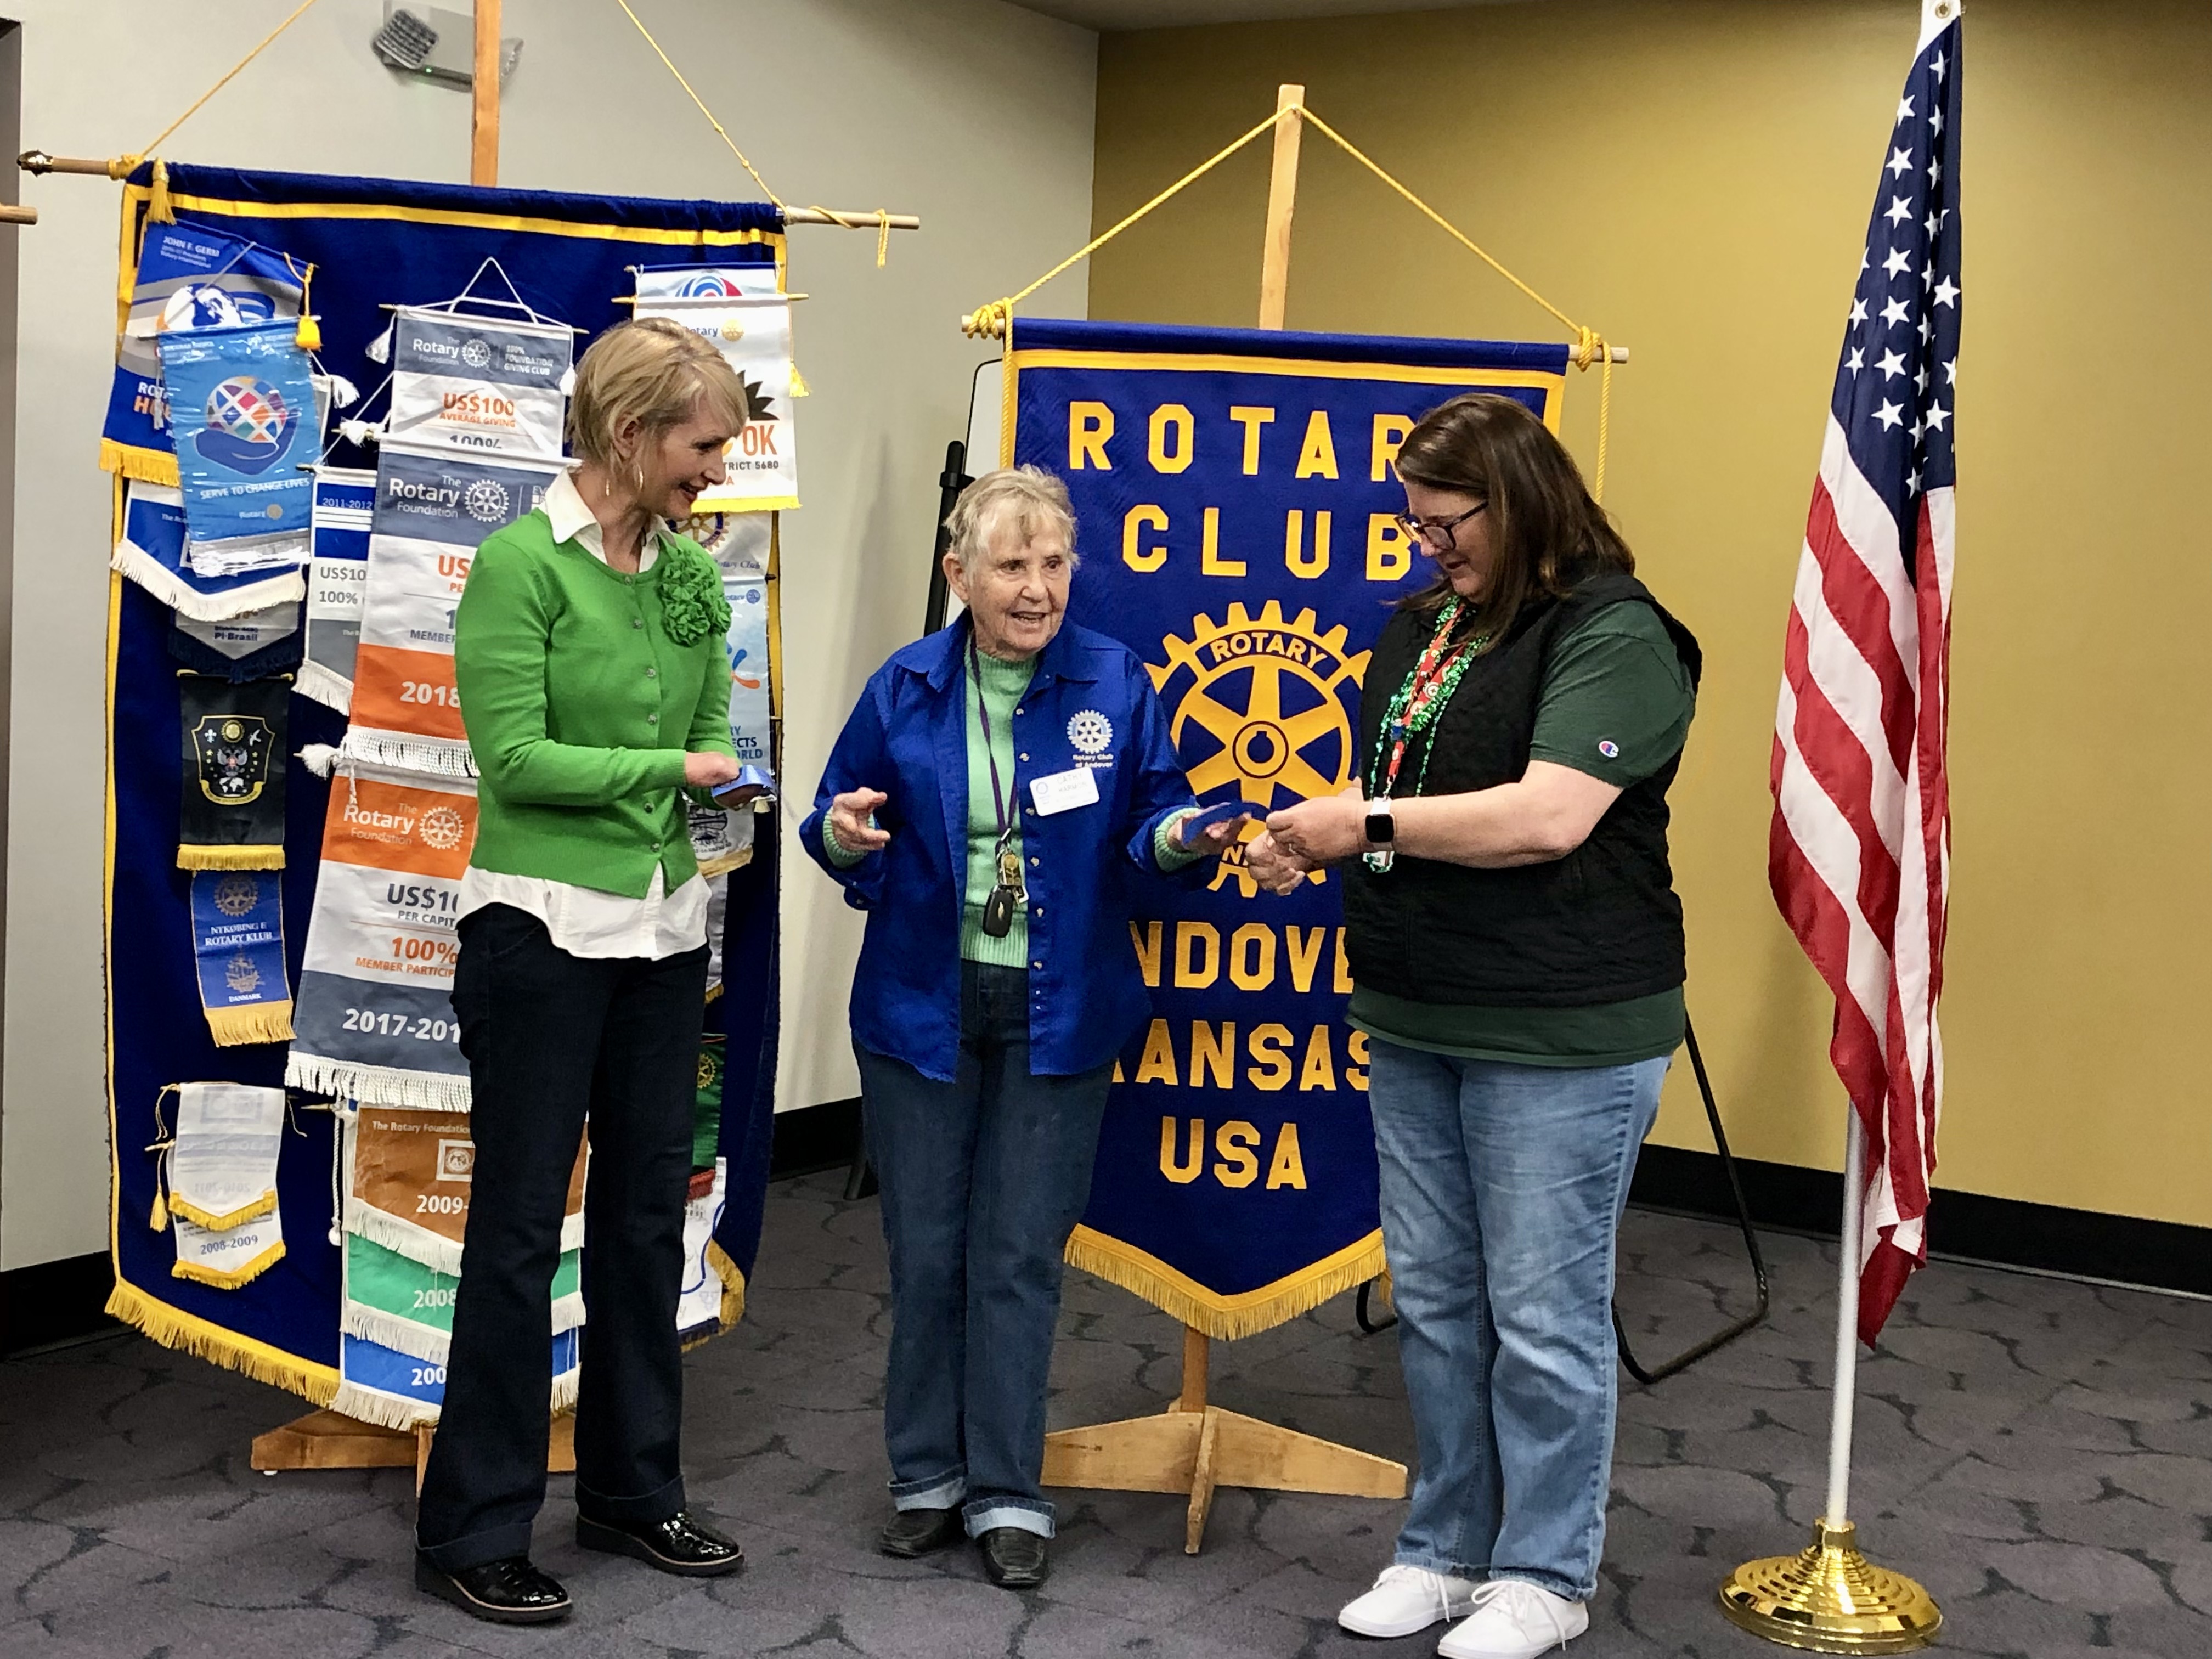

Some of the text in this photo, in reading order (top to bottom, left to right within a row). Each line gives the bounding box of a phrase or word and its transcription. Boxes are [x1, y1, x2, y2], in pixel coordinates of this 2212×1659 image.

[163, 236, 186, 249] JOHN
[195, 245, 220, 257] GERM
[687, 327, 718, 337] otary
[413, 338, 460, 359] Rotary
[443, 392, 515, 416] US$100
[439, 412, 516, 427] AVERAGE GIVING
[742, 425, 778, 456] OK
[1069, 401, 1417, 482] ROTAR
[723, 460, 779, 471] TRICT 5680
[442, 475, 462, 487] The
[200, 489, 229, 500] SERVE
[231, 486, 244, 495] TO
[388, 477, 460, 507] Rotary
[322, 497, 374, 511] 2011-2012
[397, 501, 459, 518] Foundation
[1122, 504, 1413, 581] CLUB
[320, 566, 366, 582] US$10
[438, 554, 471, 579] US
[319, 590, 358, 605] 100%
[449, 582, 463, 593] PE
[1210, 631, 1328, 670] ROTARY
[400, 681, 461, 709] 2018
[732, 737, 758, 749] ECTS
[398, 802, 418, 815] The
[343, 804, 415, 835] Rotary
[351, 827, 412, 845] Foundation
[397, 910, 456, 927] PER CAPIT
[392, 936, 459, 965] 100%
[1128, 921, 1355, 994] NDOV
[355, 957, 455, 978] MEMBER PARTICIP
[342, 1008, 461, 1044] 2017-201
[1112, 1019, 1370, 1091] ANSAS
[372, 1120, 388, 1131] The
[390, 1121, 421, 1135] Rotary
[1160, 1116, 1307, 1190] USA
[416, 1194, 469, 1215] 2009-
[200, 1234, 259, 1255] 2008-2009
[413, 1288, 456, 1308] 2008
[411, 1367, 447, 1386] 200
